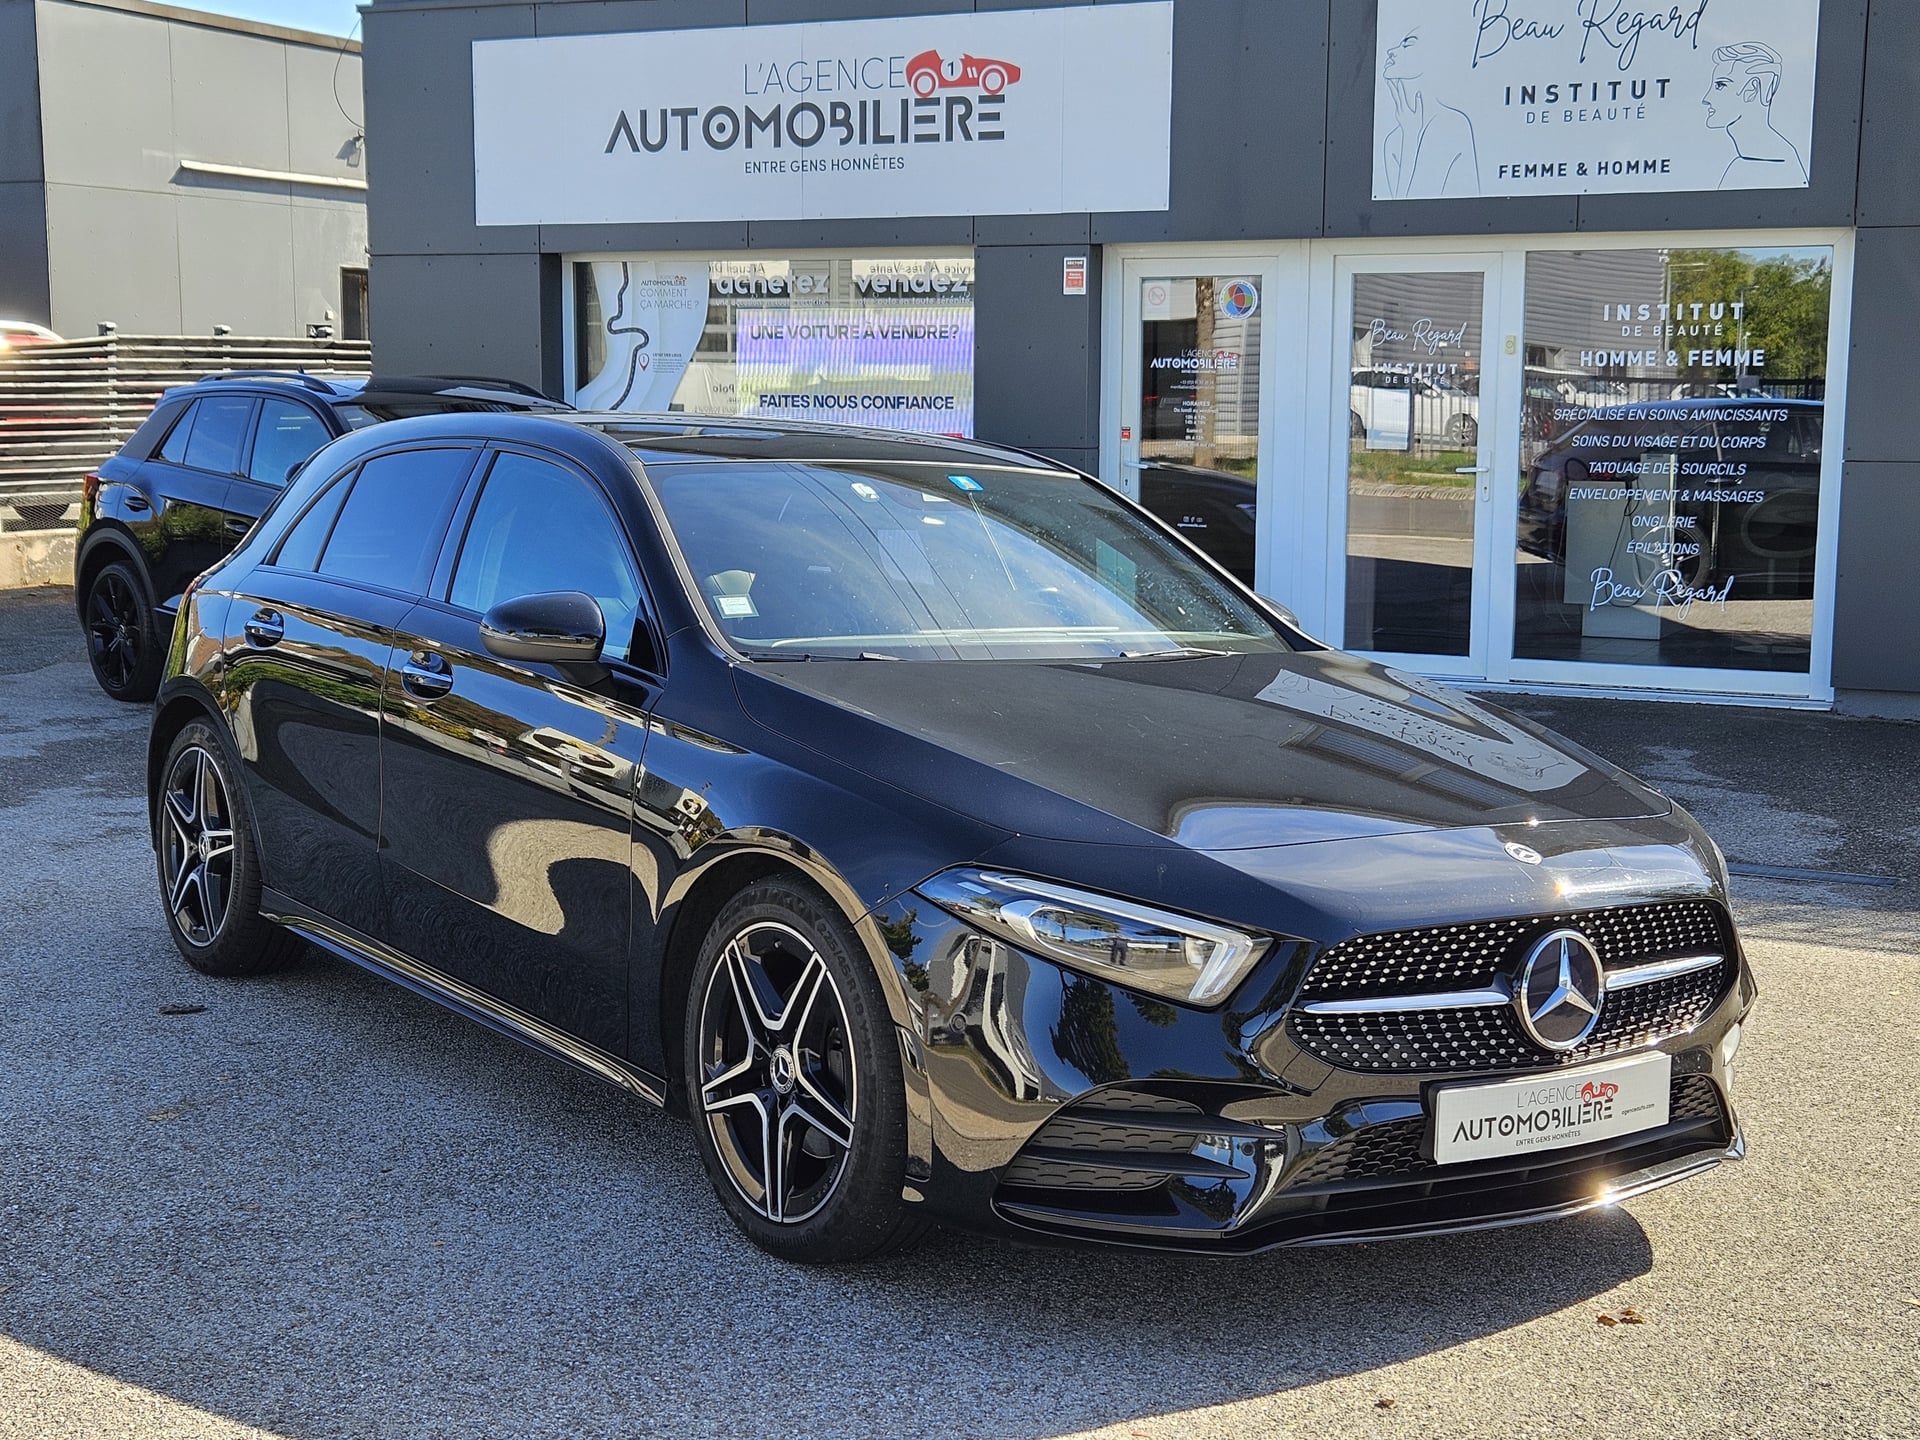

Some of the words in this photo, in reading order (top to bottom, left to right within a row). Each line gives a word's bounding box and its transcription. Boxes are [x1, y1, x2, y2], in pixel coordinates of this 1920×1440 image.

[1471, 0, 1564, 68] Beau
[1577, 0, 1708, 71] Regard
[744, 56, 905, 95] L'AGENCE
[1504, 78, 1671, 106] INSTITUT
[1526, 111, 1550, 124] DE
[1563, 103, 1646, 122] BEAUTÉ
[745, 161, 786, 174] ENTRE
[790, 159, 827, 172] GENS
[831, 153, 905, 171] HONNÊTES
[1498, 163, 1568, 179] FEMME
[1576, 162, 1588, 176] &
[1597, 159, 1671, 176] HOMME
[717, 264, 829, 295] achetez
[856, 261, 968, 293] vendez
[640, 288, 687, 297] COMMENT
[640, 300, 652, 310] ÇA
[654, 300, 692, 309] MARCHE
[1603, 303, 1744, 321] INSTITUT
[750, 325, 783, 340] UNE
[788, 325, 859, 340] VOITURE
[863, 321, 876, 339] À
[880, 325, 959, 340] VENDRE?
[1369, 319, 1408, 351] Beau
[1412, 318, 1467, 355] Regard
[1621, 326, 1642, 337] DE
[1653, 324, 1723, 336] BEAUTÉ
[1580, 350, 1657, 367] HOMME
[1665, 351, 1678, 366] &
[1688, 350, 1765, 367] FEMME
[1375, 363, 1458, 374] INSTITUT
[1385, 376, 1398, 384] DE
[1404, 375, 1445, 385] BEAUTÉ
[759, 394, 810, 409] FAITES
[813, 395, 857, 409] NOUS
[861, 395, 955, 410] CONFIANCE
[1553, 406, 1625, 421] SPÉCIALISÉ
[1628, 409, 1645, 420] EN
[1648, 409, 1688, 421] SOINS
[1689, 408, 1789, 421] AMINCISSANTS
[1571, 435, 1609, 448] SOINS
[1612, 436, 1631, 447] DU
[1633, 436, 1678, 448] VISAGE
[1680, 436, 1698, 448] ET
[1699, 436, 1719, 448] DU
[1721, 436, 1767, 449] CORPS
[1588, 462, 1650, 474] TATOUAGE
[1652, 462, 1679, 475] DES
[1680, 462, 1747, 476] SOURCILS
[1569, 488, 1680, 501] ENVELOPPEMENT
[1681, 489, 1690, 502] &
[1692, 489, 1765, 503] MASSAGES
[1631, 515, 1698, 529] ONGLERIE
[1626, 539, 1700, 555] ÉPILATIONS
[1589, 567, 1647, 612] Beau
[1653, 568, 1735, 621] Regard
[1516, 1083, 1583, 1109] L'AGENCE
[1515, 1137, 1534, 1147] ENTRE
[1535, 1134, 1552, 1145] GENS
